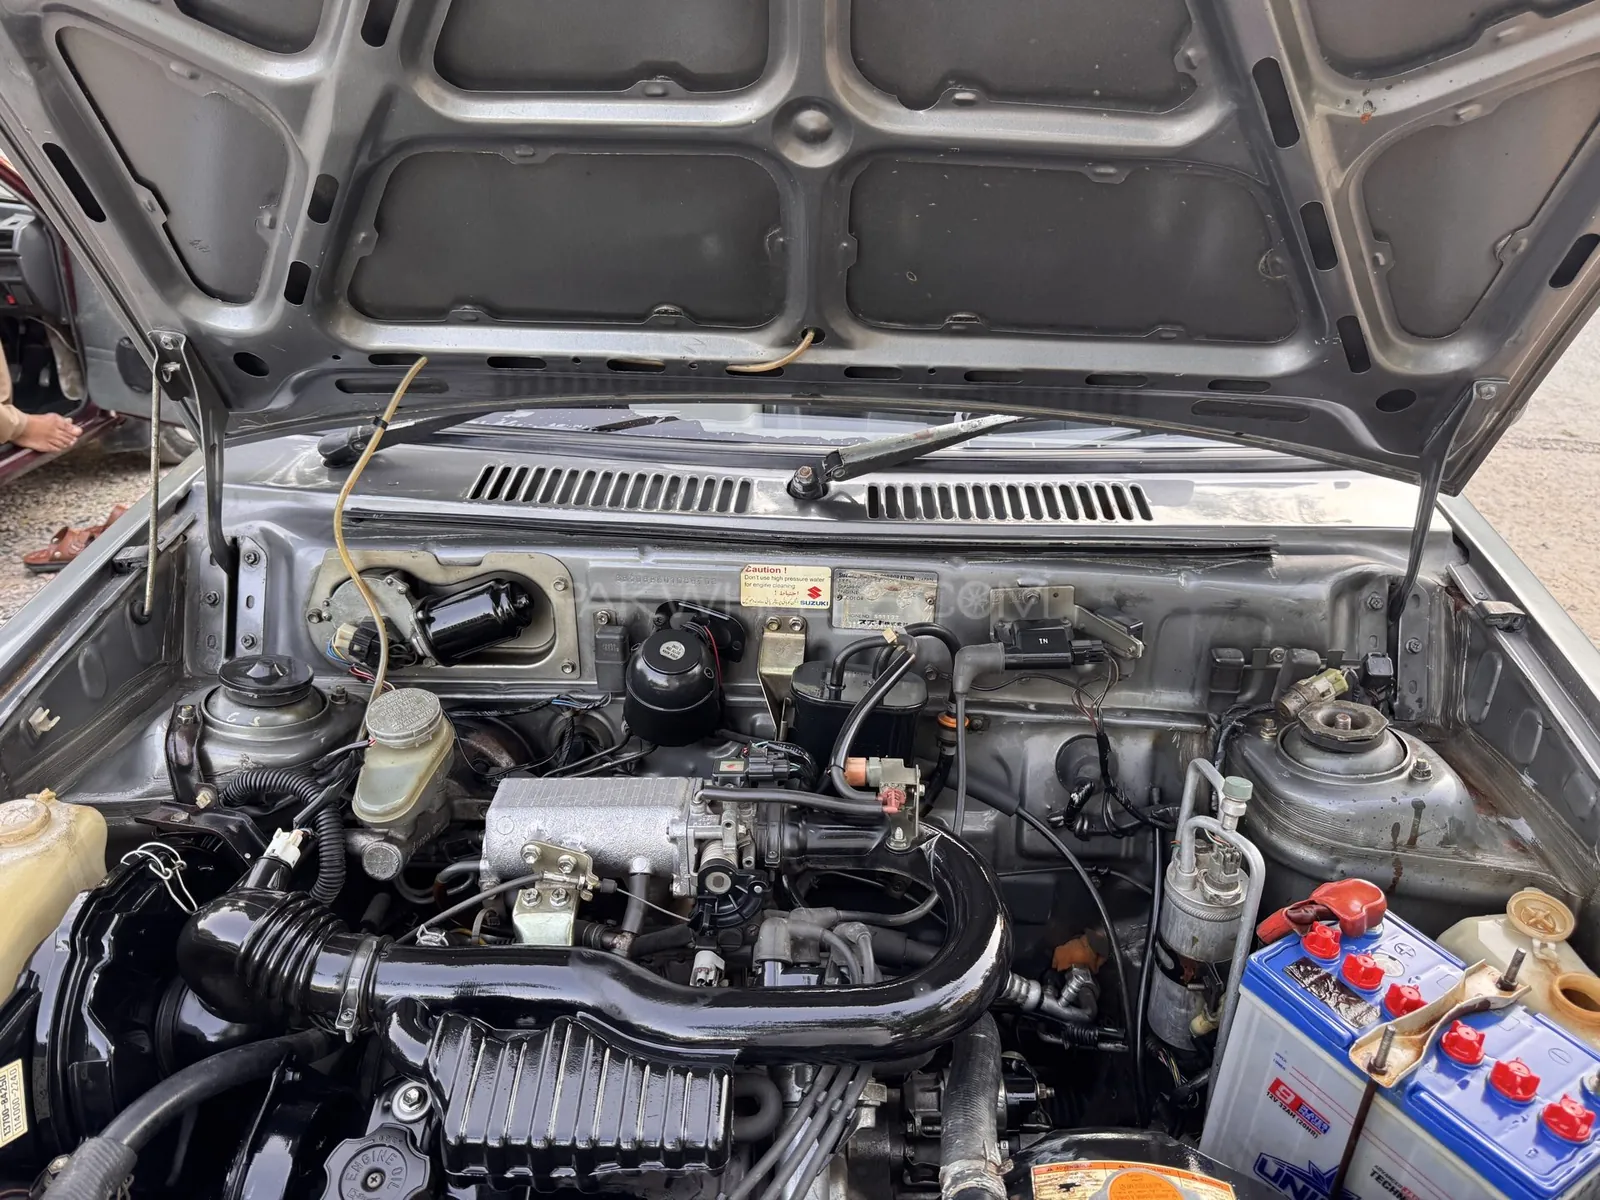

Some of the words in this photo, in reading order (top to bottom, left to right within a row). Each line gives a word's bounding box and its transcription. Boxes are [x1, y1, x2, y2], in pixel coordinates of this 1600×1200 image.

[745, 566, 781, 574] Caution
[9, 1068, 21, 1131] 114000-2240
[1266, 1091, 1279, 1103] 12V
[345, 1149, 398, 1182] ENGINE
[386, 1166, 404, 1190] OIL
